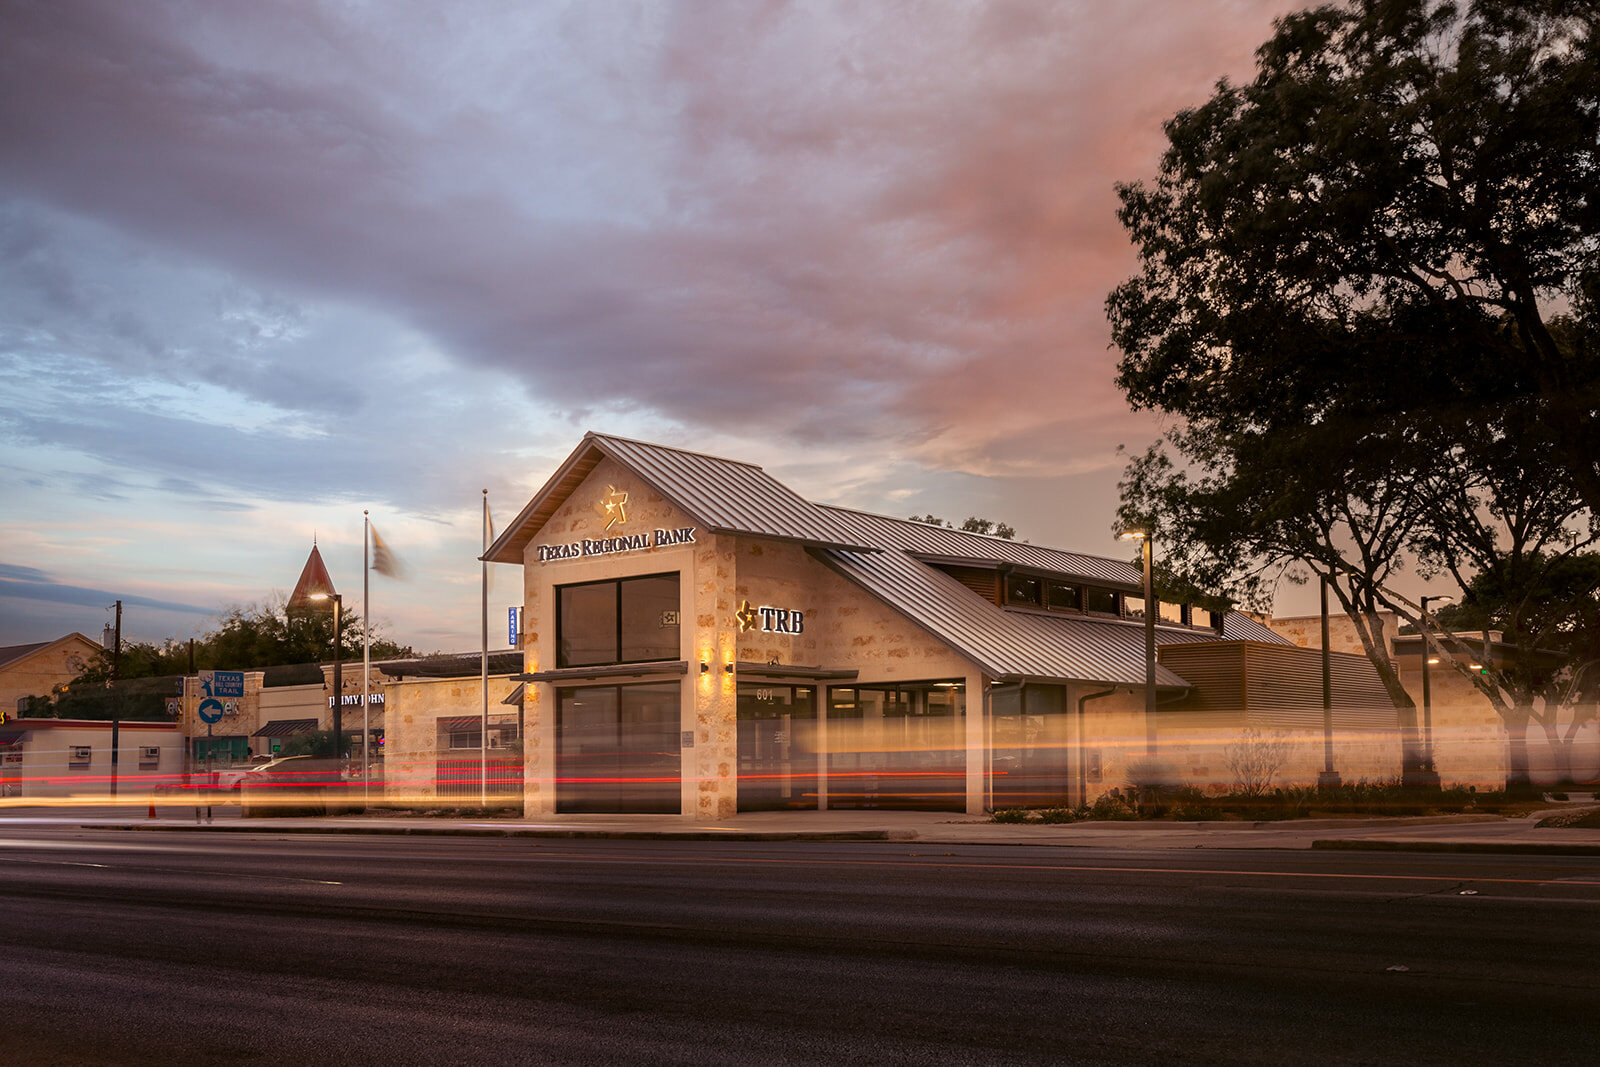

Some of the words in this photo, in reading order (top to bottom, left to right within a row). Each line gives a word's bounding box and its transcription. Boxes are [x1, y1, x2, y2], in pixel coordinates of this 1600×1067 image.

[537, 543, 582, 562] TEXAS
[581, 533, 653, 557] REGIONAL
[653, 527, 696, 548] BANK
[758, 606, 804, 635] TRB
[219, 687, 239, 695] TRAIL
[756, 688, 773, 701] 601
